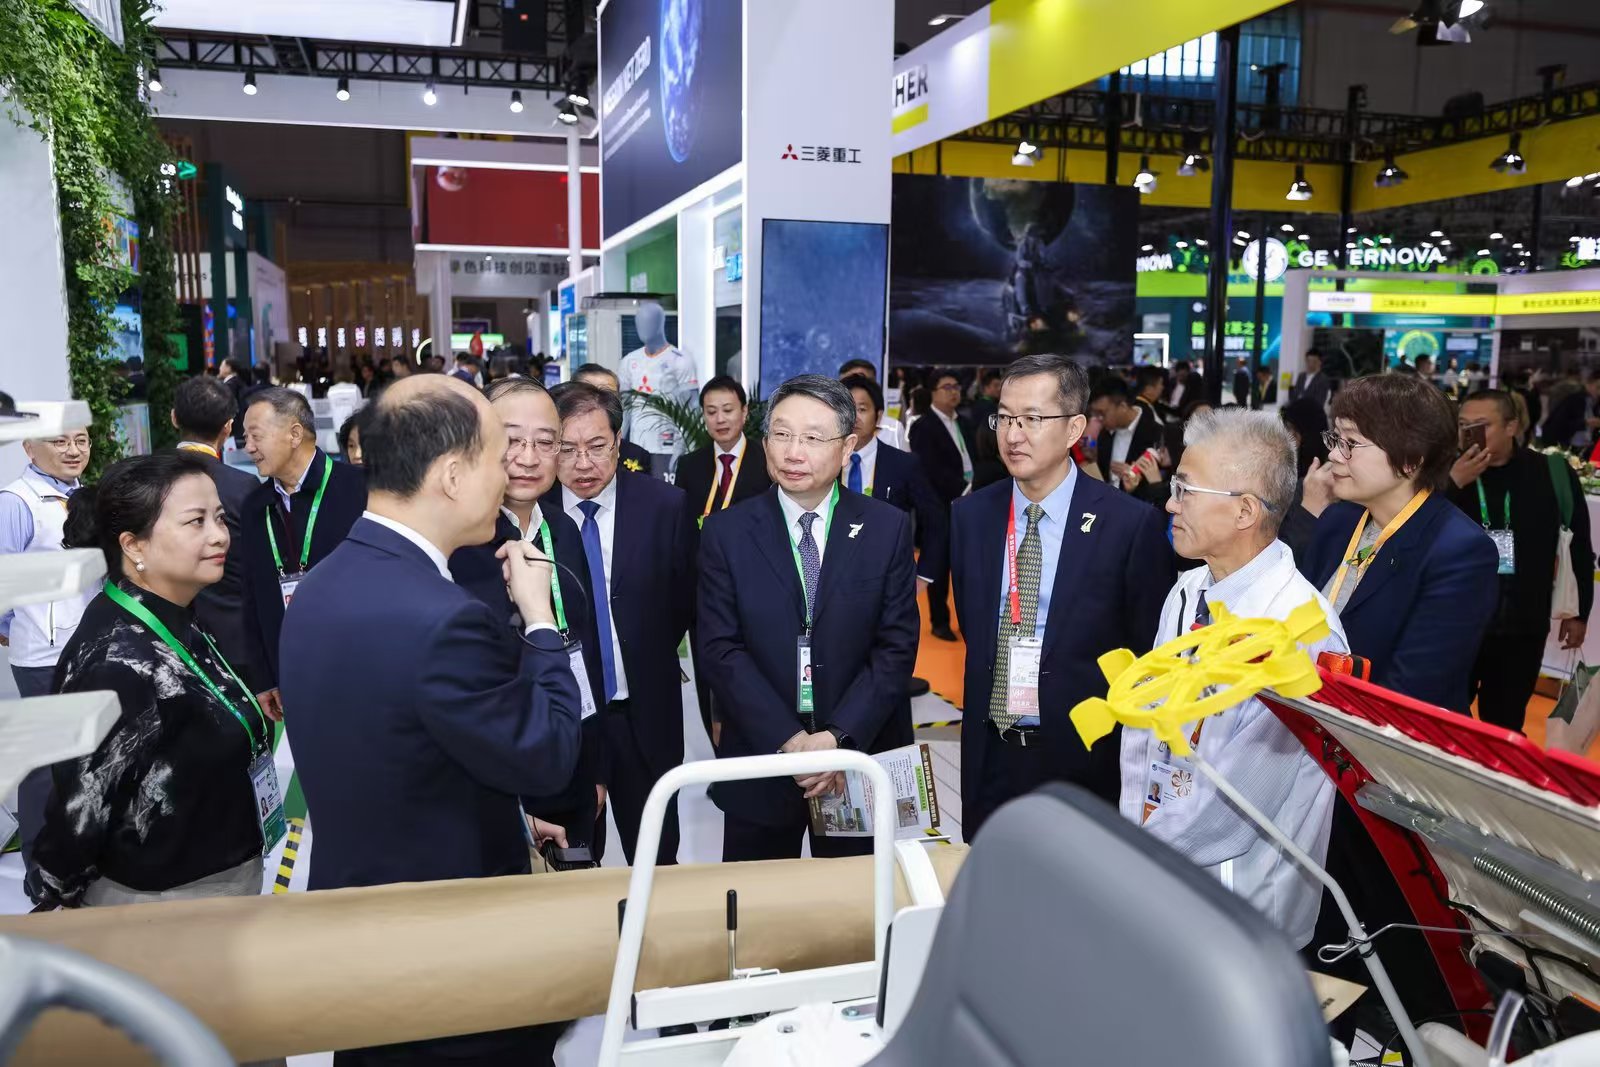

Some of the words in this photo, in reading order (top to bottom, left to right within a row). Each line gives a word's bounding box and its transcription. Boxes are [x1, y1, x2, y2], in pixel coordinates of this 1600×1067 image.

[801, 146, 862, 163] 三菱重工
[1298, 250, 1328, 267] GE
[1333, 247, 1443, 266] ERNOVA
